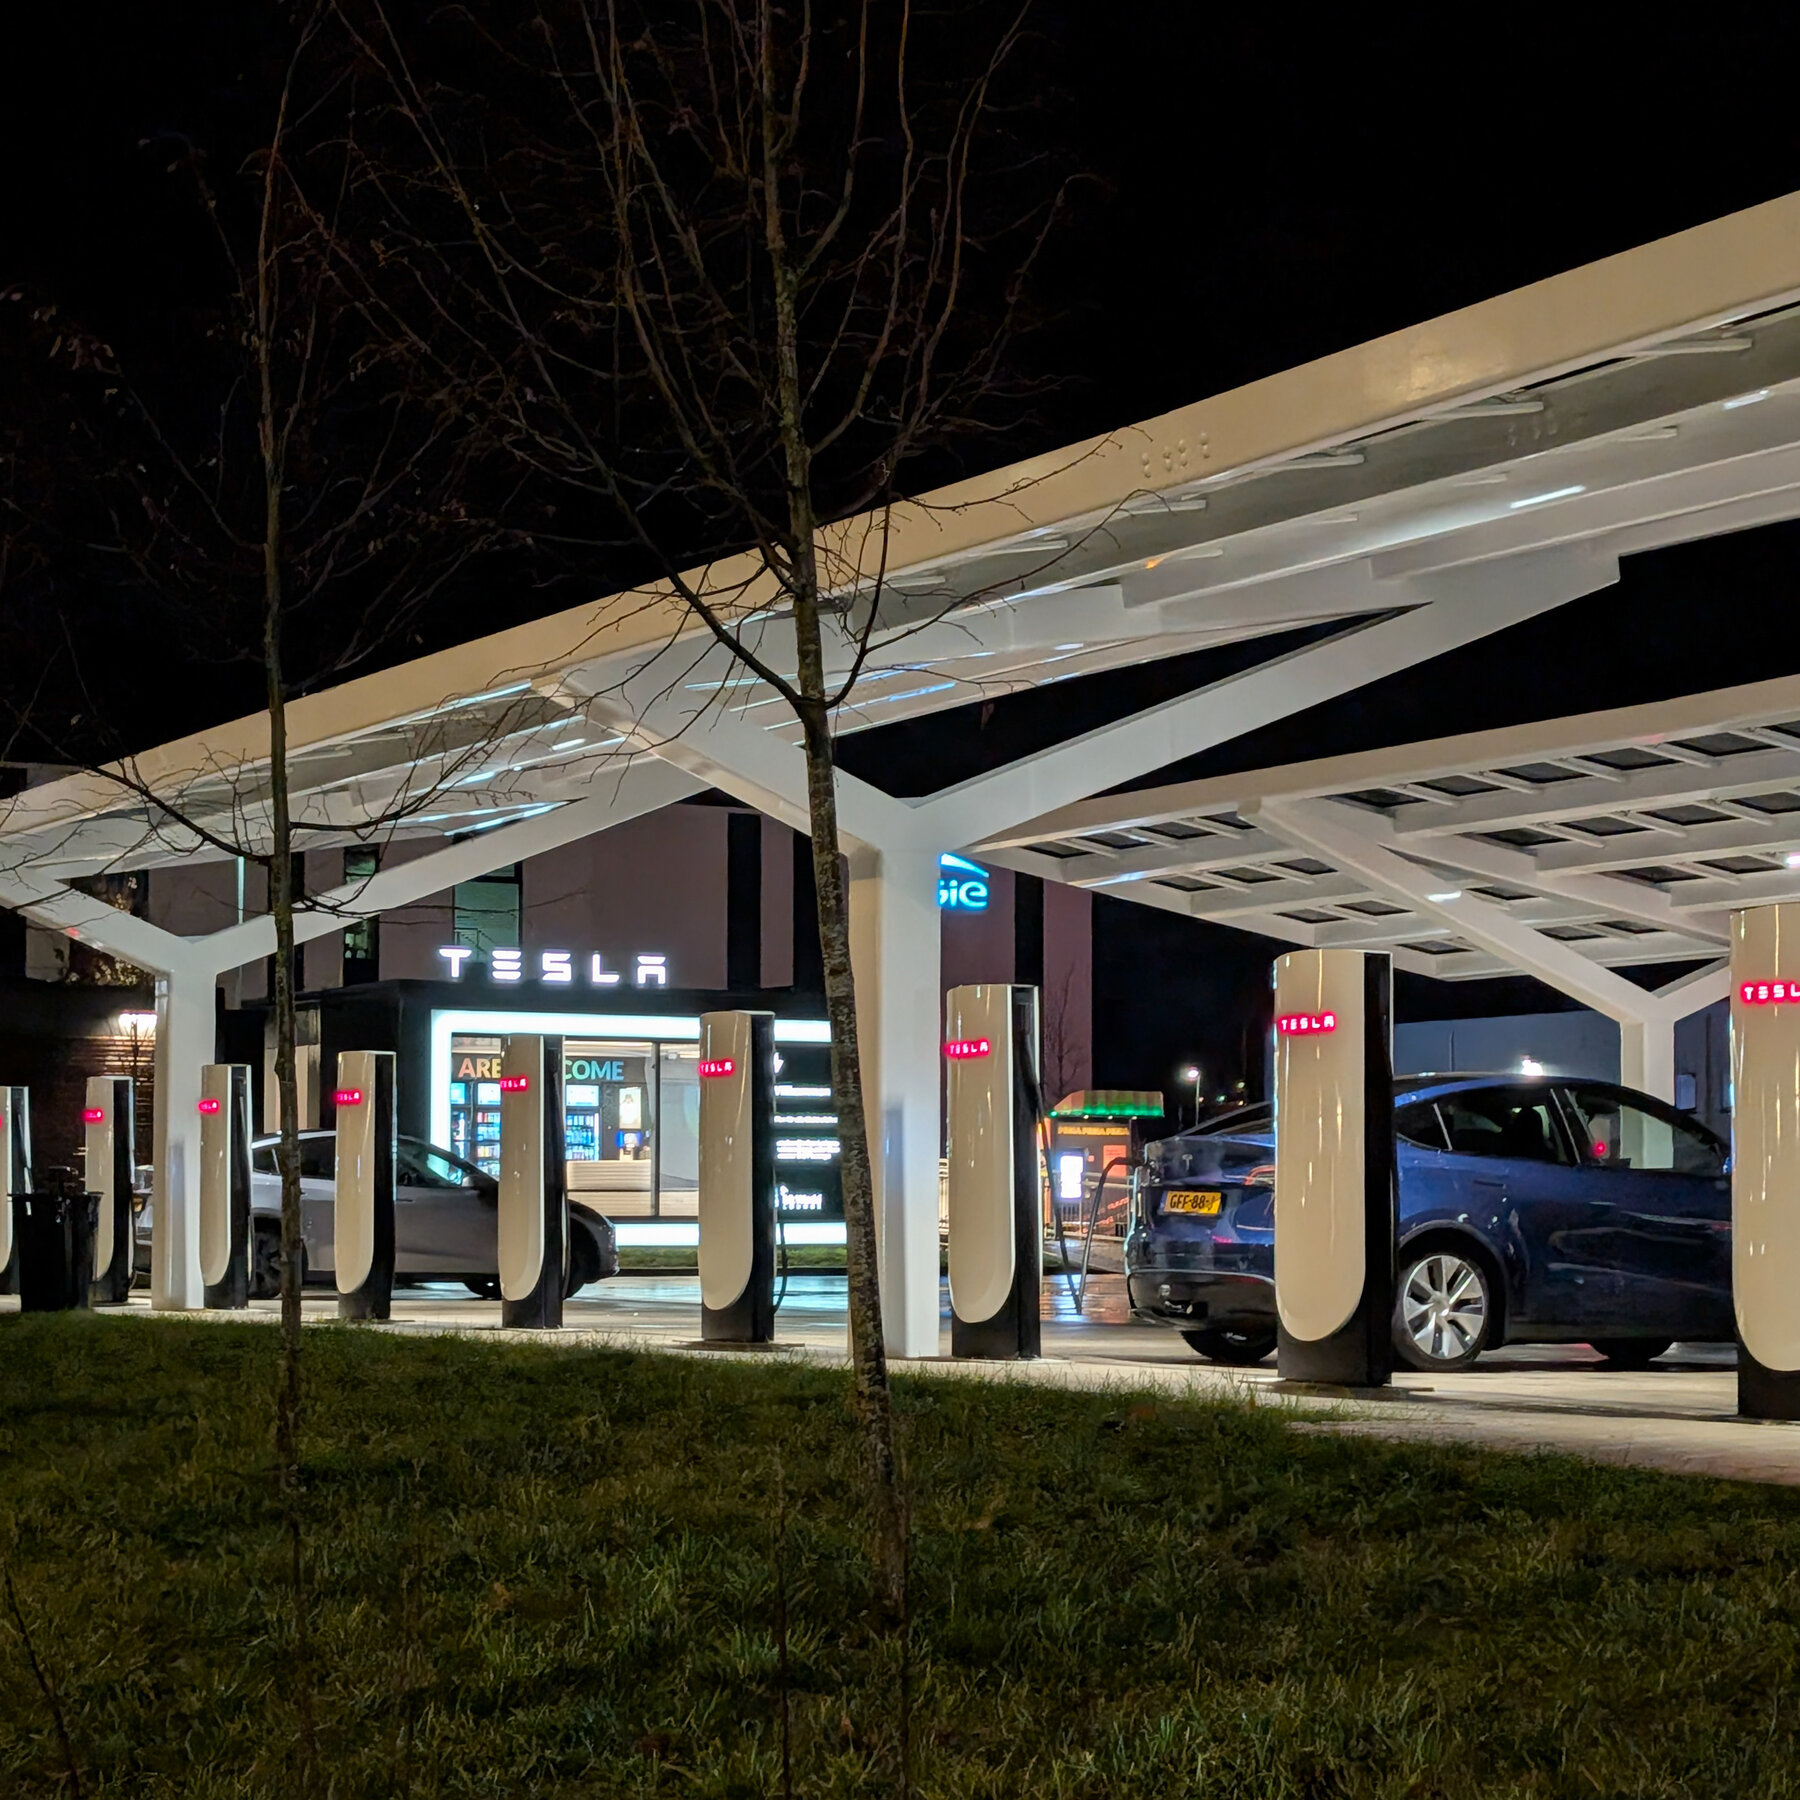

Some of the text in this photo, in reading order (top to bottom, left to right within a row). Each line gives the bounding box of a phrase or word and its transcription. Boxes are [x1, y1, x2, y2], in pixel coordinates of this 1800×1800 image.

[438, 947, 668, 985] TESLA
[1280, 1014, 1335, 1031] TESLA
[457, 1057, 502, 1079] ARE
